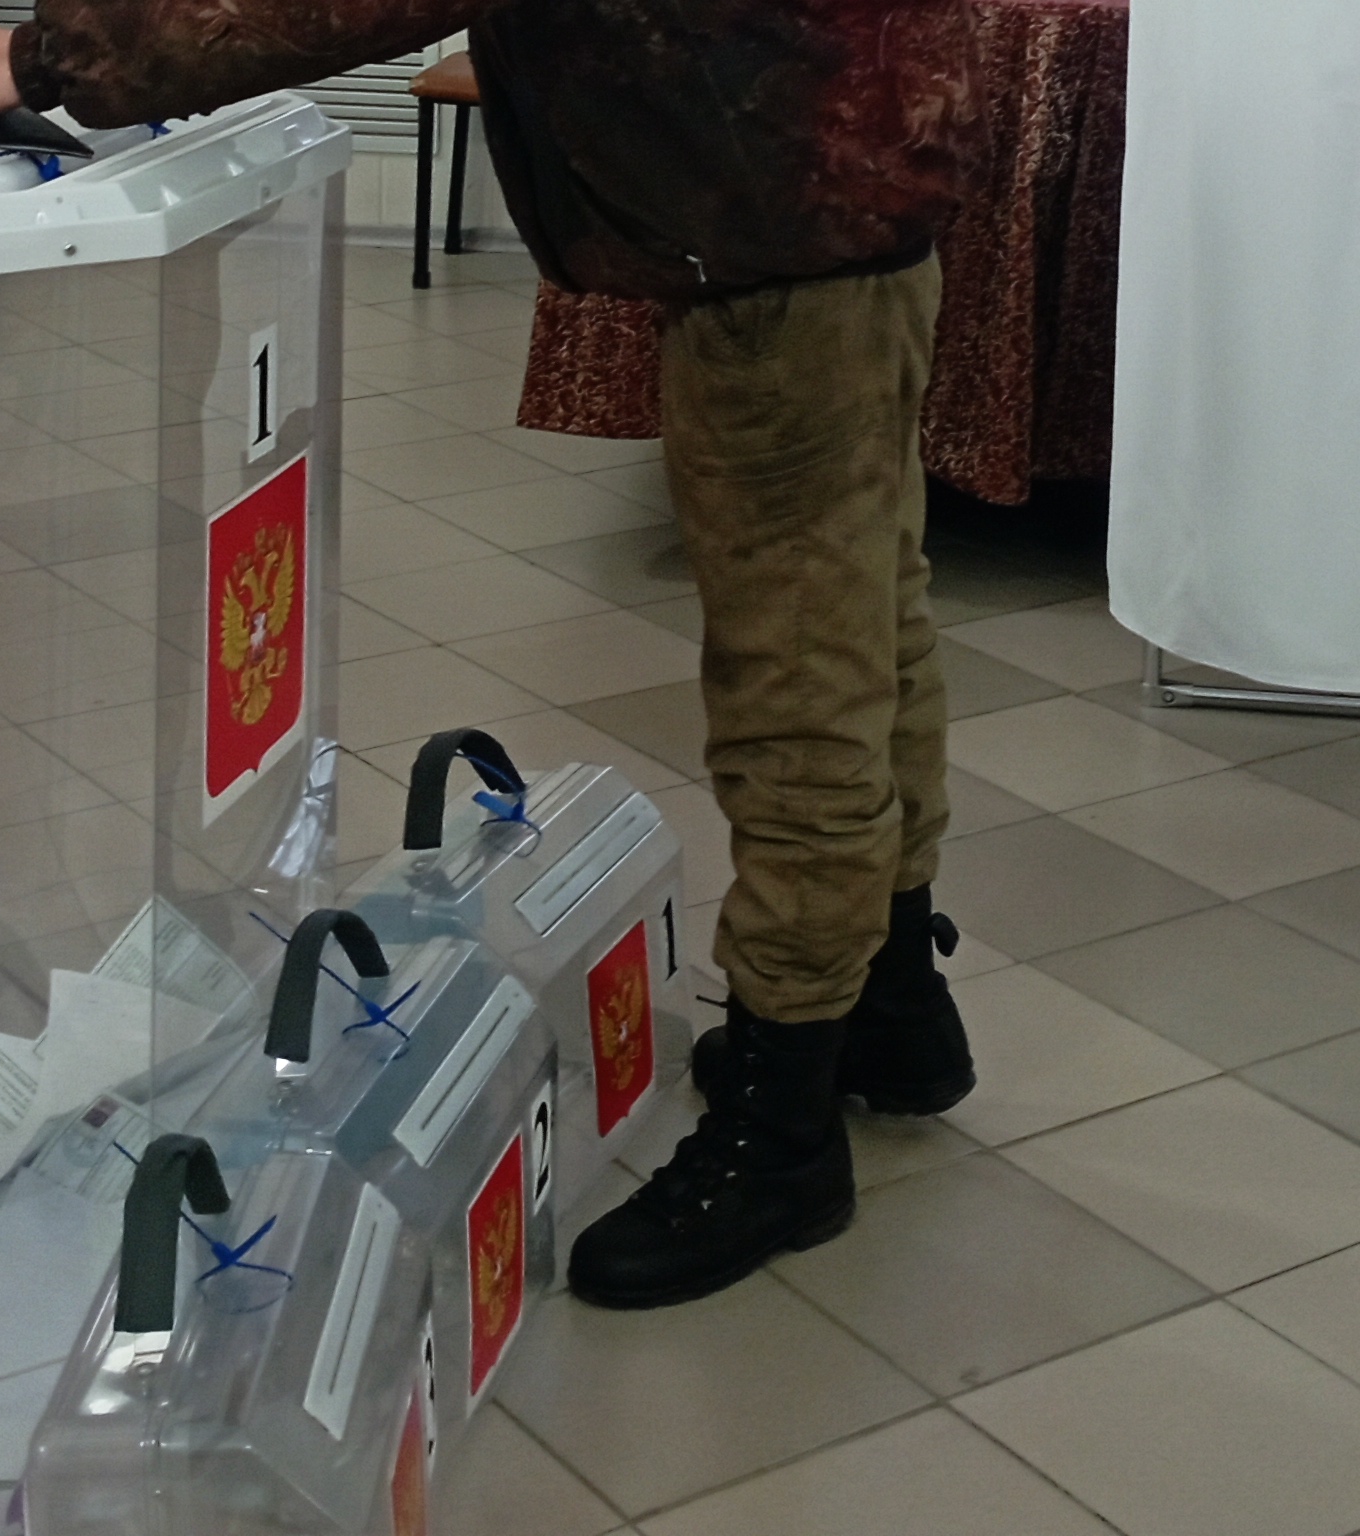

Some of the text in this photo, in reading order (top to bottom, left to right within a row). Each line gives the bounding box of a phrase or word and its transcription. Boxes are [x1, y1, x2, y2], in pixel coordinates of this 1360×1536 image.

[252, 343, 272, 446] 1
[661, 896, 678, 982] 1
[534, 1100, 549, 1200] 2
